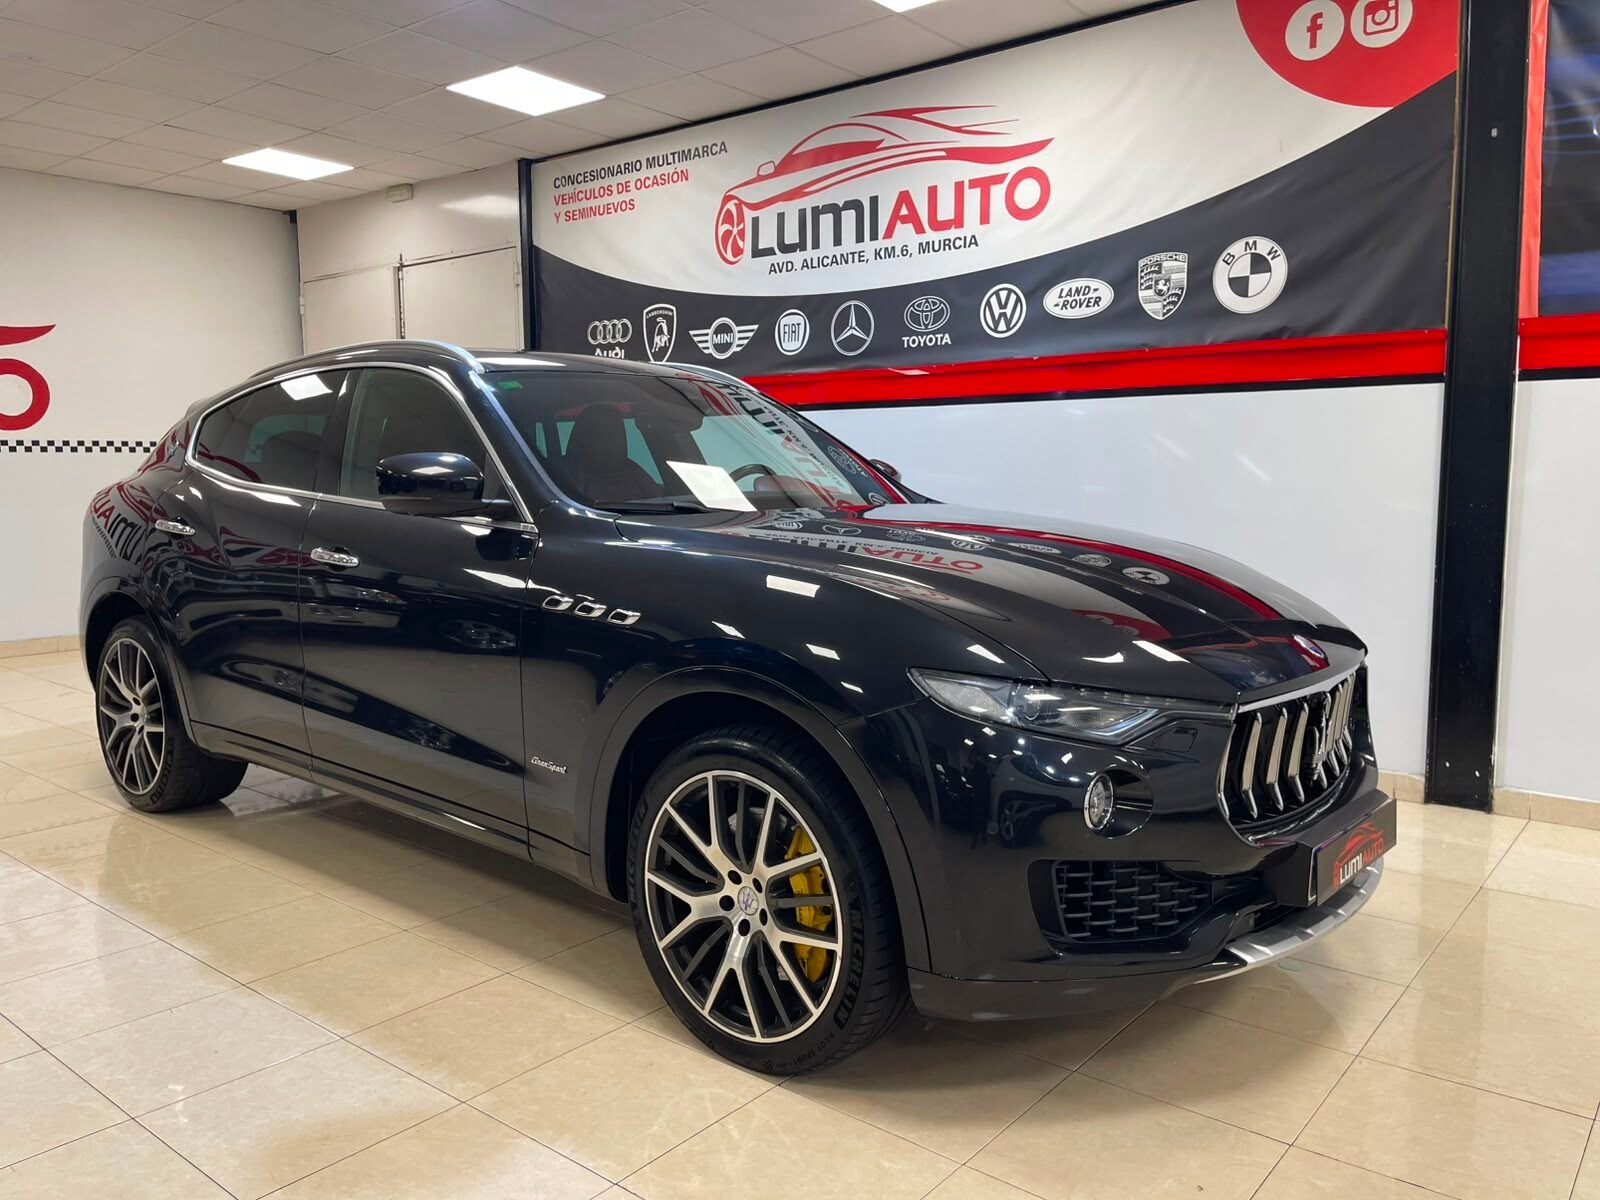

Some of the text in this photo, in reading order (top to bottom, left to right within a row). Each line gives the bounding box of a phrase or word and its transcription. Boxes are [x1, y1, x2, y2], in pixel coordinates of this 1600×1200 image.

[553, 141, 728, 189] CONCESIONARIO MULTIMARCA
[554, 167, 689, 206] VEHÍCULOS DE OCASIÓN
[554, 198, 636, 224] Y SEMINUEVOS
[768, 234, 979, 275] AVD. ALICANTE, KM.6, MURCIA
[1140, 254, 1187, 267] PORSCHE
[1222, 240, 1281, 266] BMW
[712, 332, 734, 345] MINI
[783, 322, 801, 343] FIAT
[902, 333, 952, 348] TOYOTA
